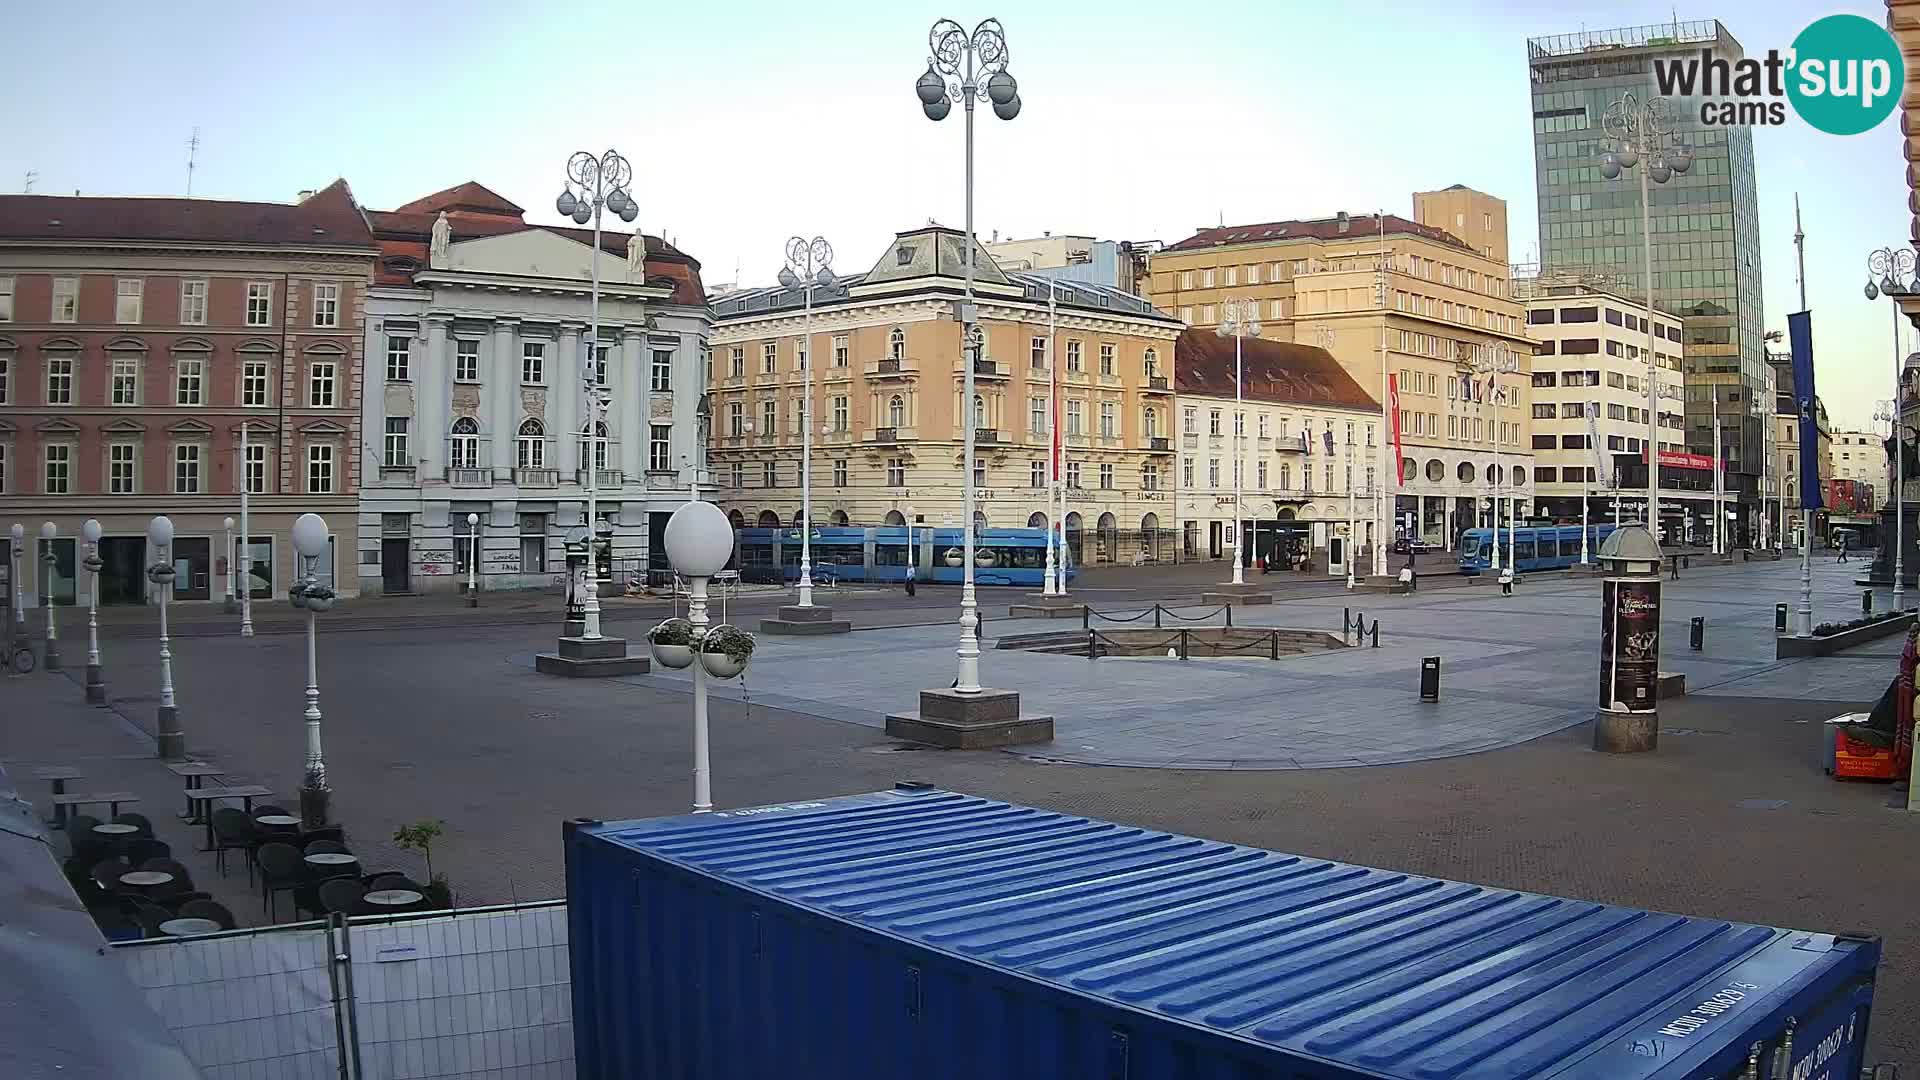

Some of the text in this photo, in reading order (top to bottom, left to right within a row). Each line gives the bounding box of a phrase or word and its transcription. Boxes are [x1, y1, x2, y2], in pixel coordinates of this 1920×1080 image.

[960, 489, 995, 499] SGER
[1657, 1015, 1708, 1037] MCDU
[1691, 988, 1745, 1017] 300629
